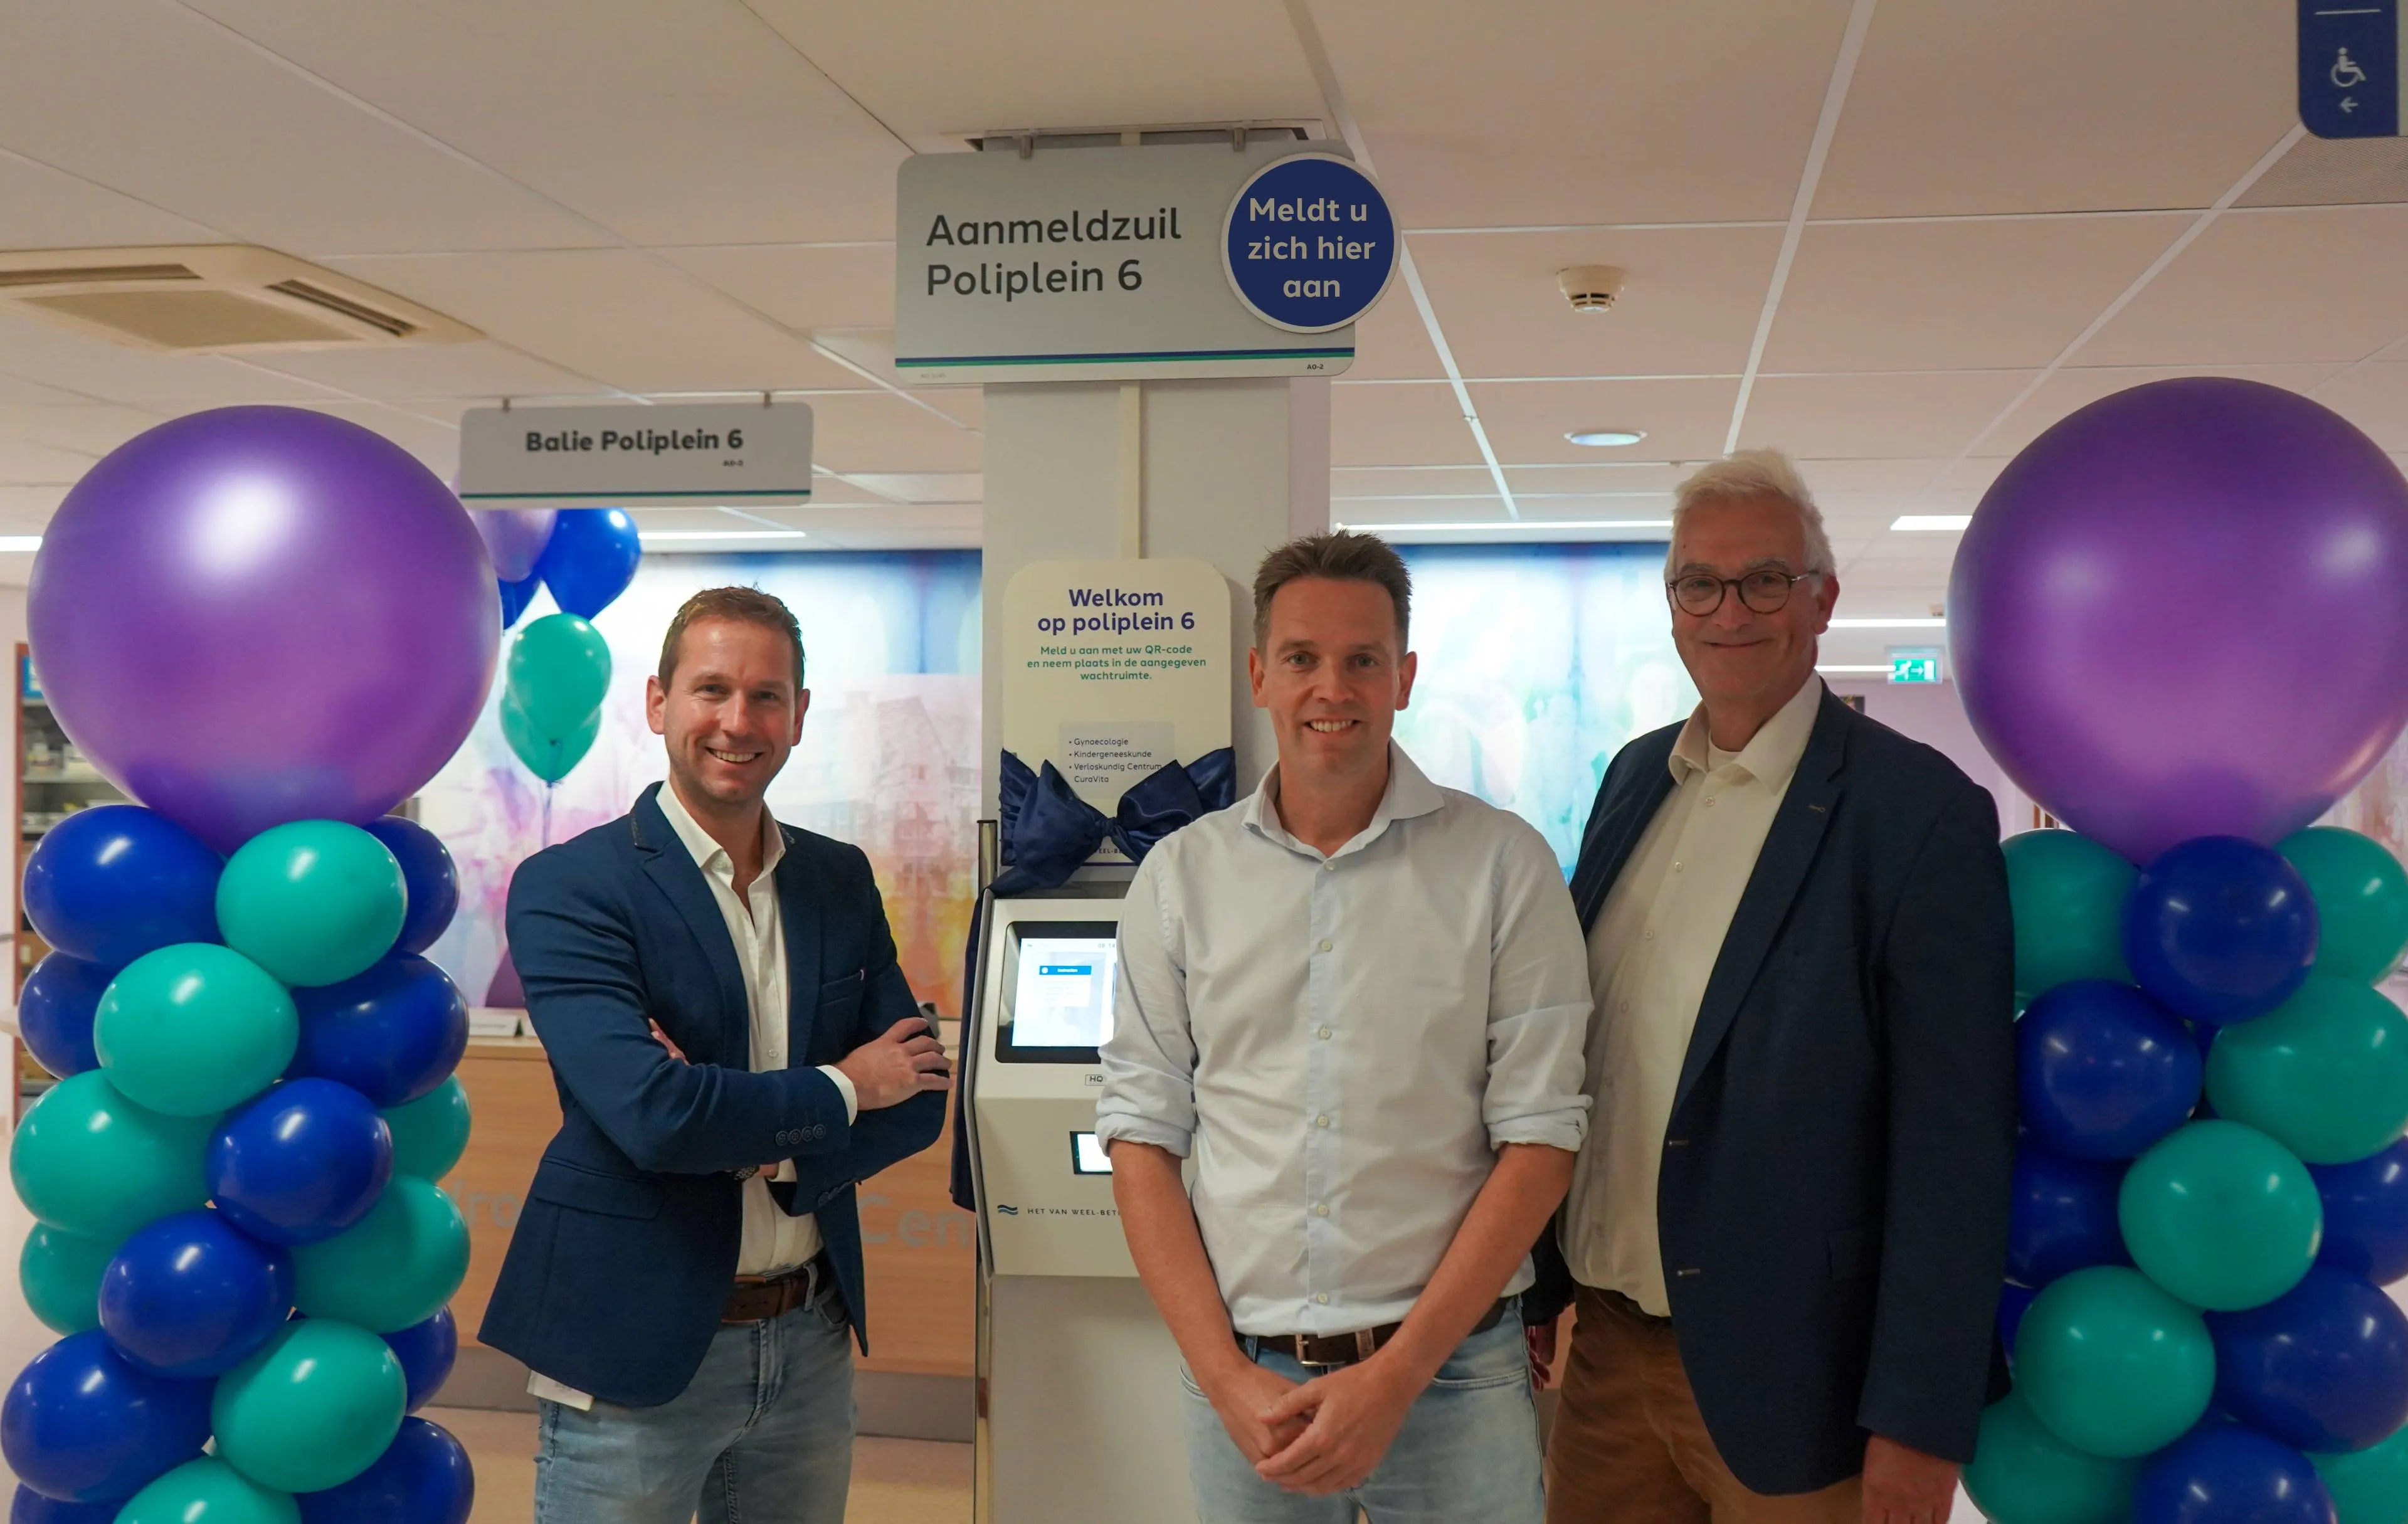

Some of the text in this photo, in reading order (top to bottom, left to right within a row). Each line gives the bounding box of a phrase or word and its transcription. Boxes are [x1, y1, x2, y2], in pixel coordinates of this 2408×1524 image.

[1250, 198, 1368, 222] Meldt u
[926, 207, 1182, 246] Aanmeldzuil
[1248, 235, 1376, 260] zich hier
[927, 258, 1143, 302] Poliplein 6
[1283, 280, 1341, 298] aan
[526, 428, 744, 456] Balie Poliplein 6
[1068, 588, 1164, 607] Welkom
[1037, 611, 1195, 636] op poliplein 6
[1040, 646, 1067, 655] Meld
[1102, 646, 1123, 655] met
[1144, 644, 1193, 655] QR-code
[1074, 659, 1109, 670] plaats
[1112, 658, 1121, 667] in
[1124, 658, 1138, 667] de
[1140, 659, 1207, 669] aangegeven
[1080, 670, 1153, 680] wachtruimte.
[1074, 738, 1129, 747] Gynaecologie
[1074, 750, 1152, 759] Kindergeneeskunde
[1074, 763, 1125, 772] Verloskundig
[1089, 1075, 1104, 1083] HQ
